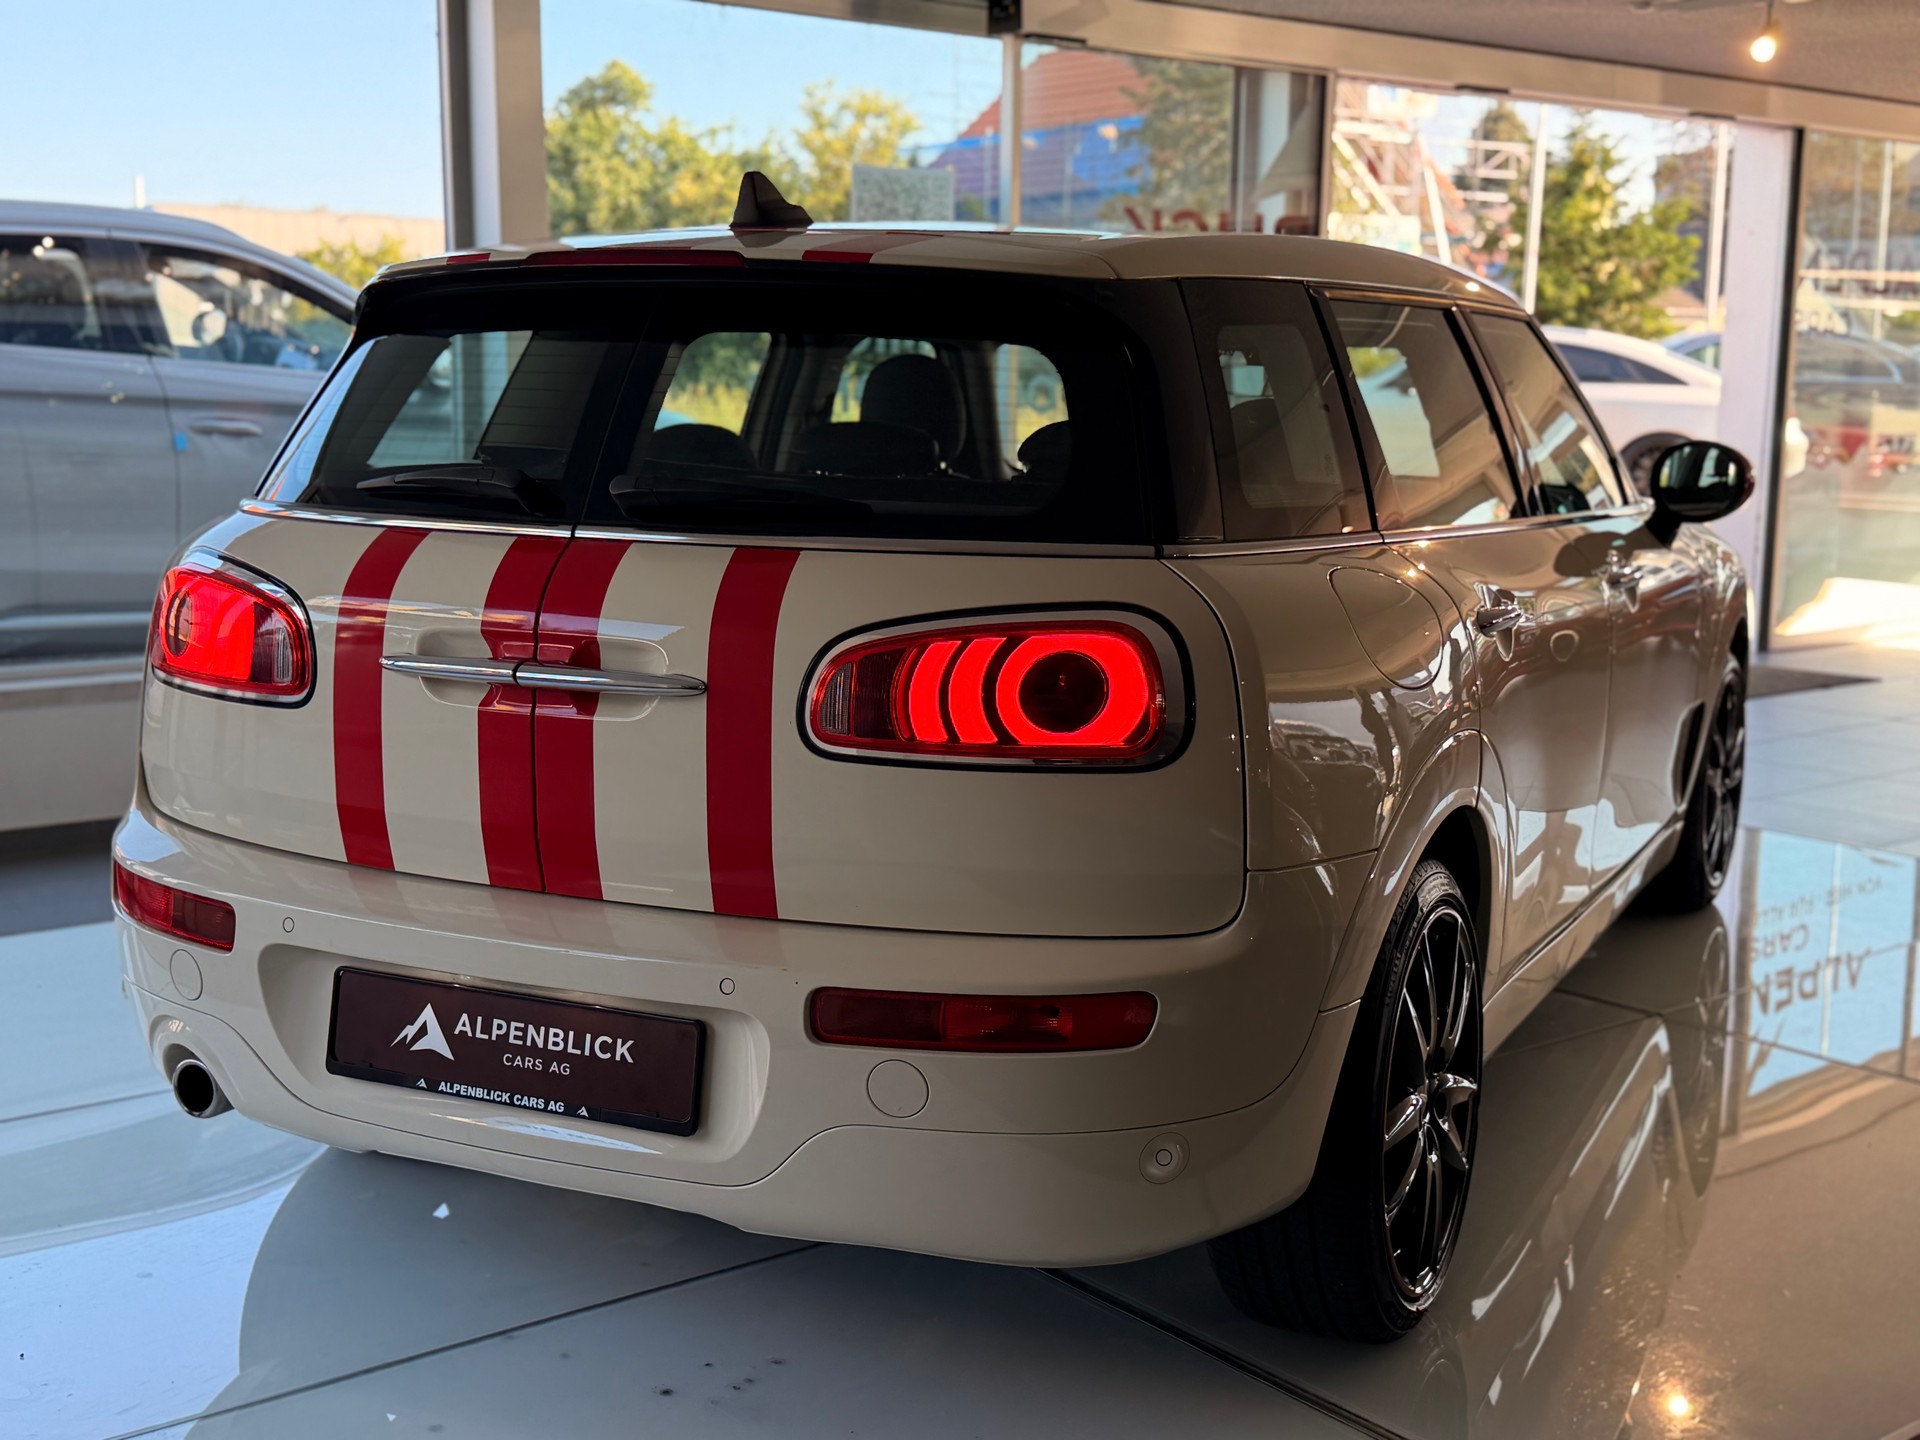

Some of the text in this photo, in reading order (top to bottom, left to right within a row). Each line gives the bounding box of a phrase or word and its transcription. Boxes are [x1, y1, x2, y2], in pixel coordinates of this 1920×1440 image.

[454, 1012, 635, 1063] ALPENBLICK
[502, 1053, 571, 1076] CARS AG
[438, 1081, 565, 1113] ALPENBLICK CARS AG
